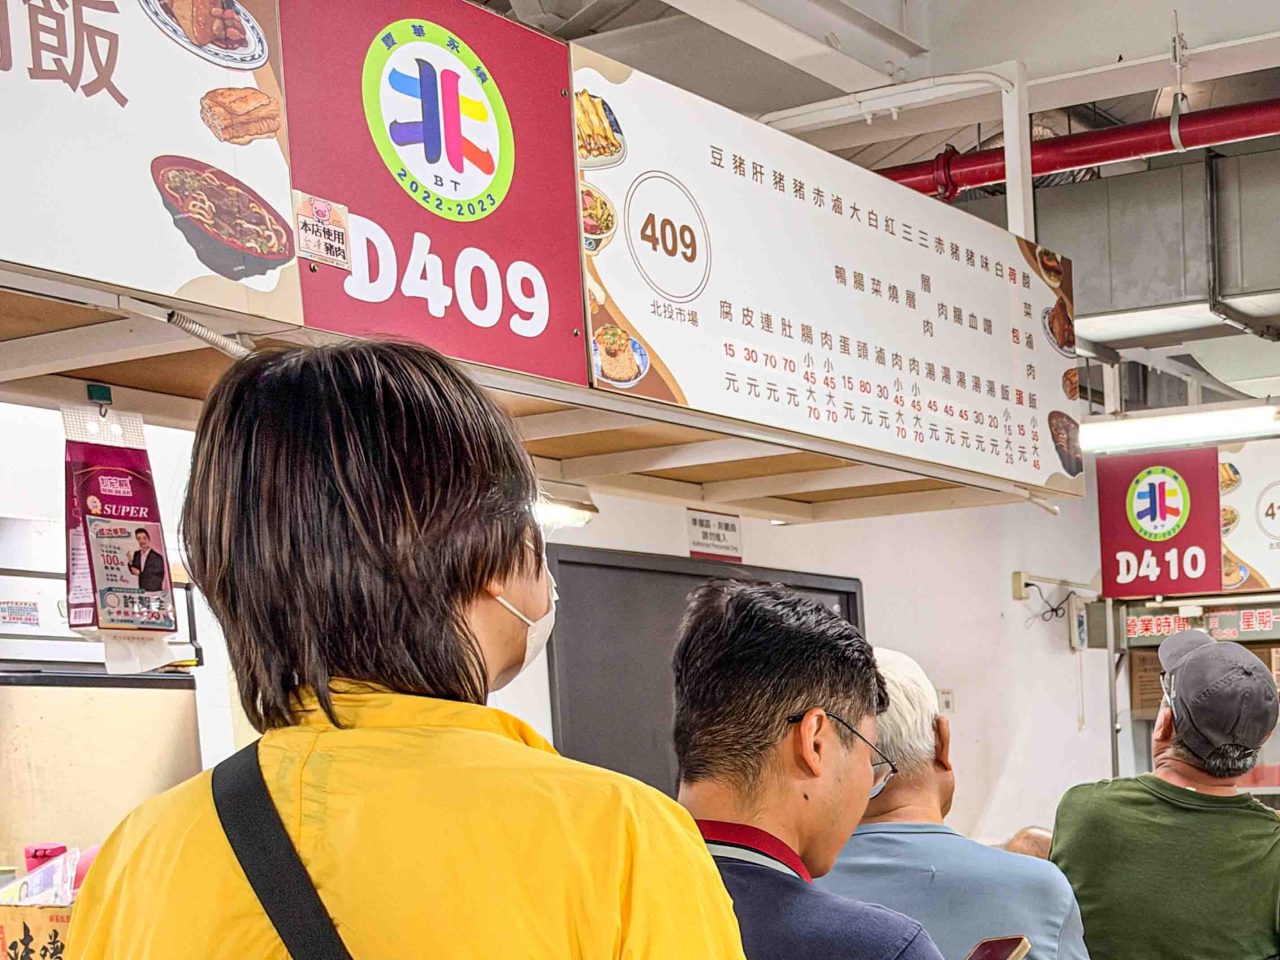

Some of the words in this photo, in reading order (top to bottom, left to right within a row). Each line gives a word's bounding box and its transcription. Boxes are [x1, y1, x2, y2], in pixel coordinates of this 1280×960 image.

[0, 0, 129, 108] 飯
[397, 168, 496, 216] 2022-2023
[300, 220, 344, 245] 本店使用
[640, 213, 697, 263] 409
[343, 213, 549, 339] D409
[650, 299, 699, 327] 北投市場
[104, 503, 149, 518] SUPER
[1115, 546, 1206, 584] D410
